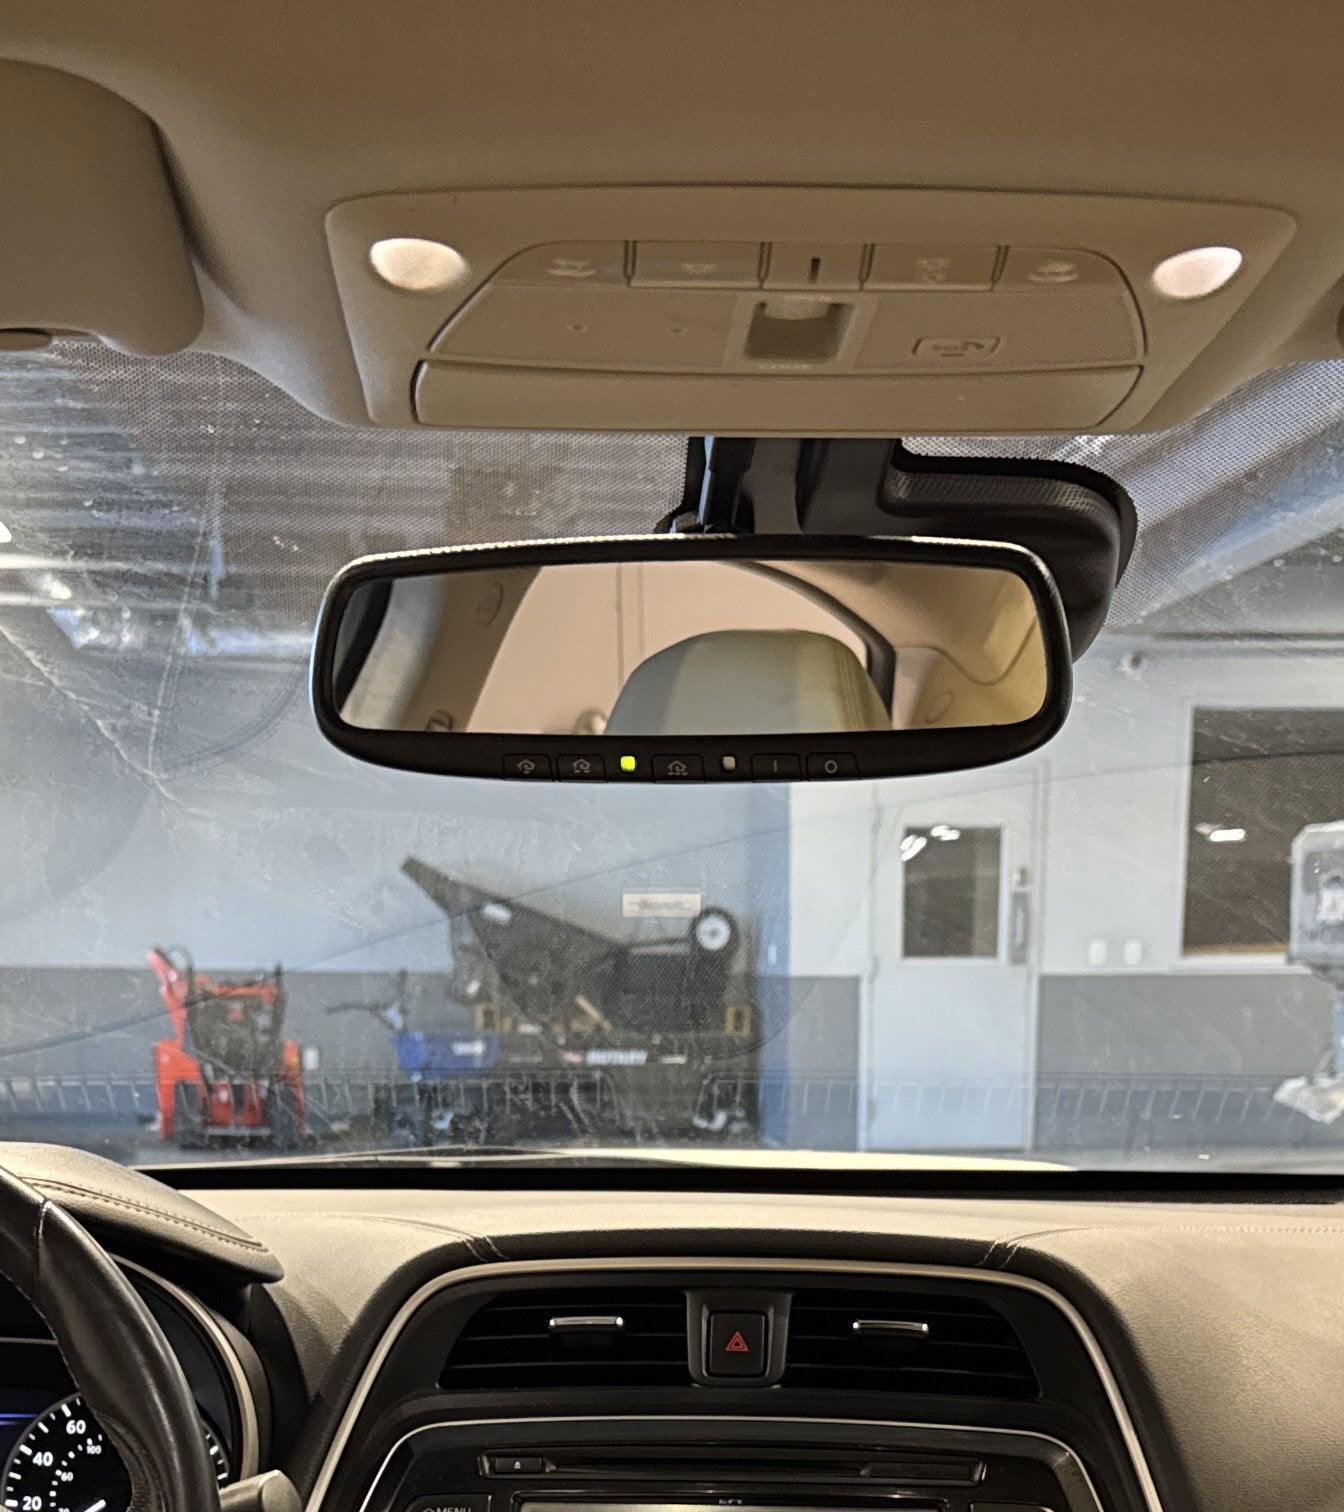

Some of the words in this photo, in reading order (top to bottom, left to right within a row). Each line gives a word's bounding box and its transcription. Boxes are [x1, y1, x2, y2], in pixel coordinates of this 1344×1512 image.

[66, 1419, 87, 1435] 60
[32, 1451, 54, 1467] 40
[60, 1472, 74, 1482] 60
[22, 1495, 42, 1511] 20
